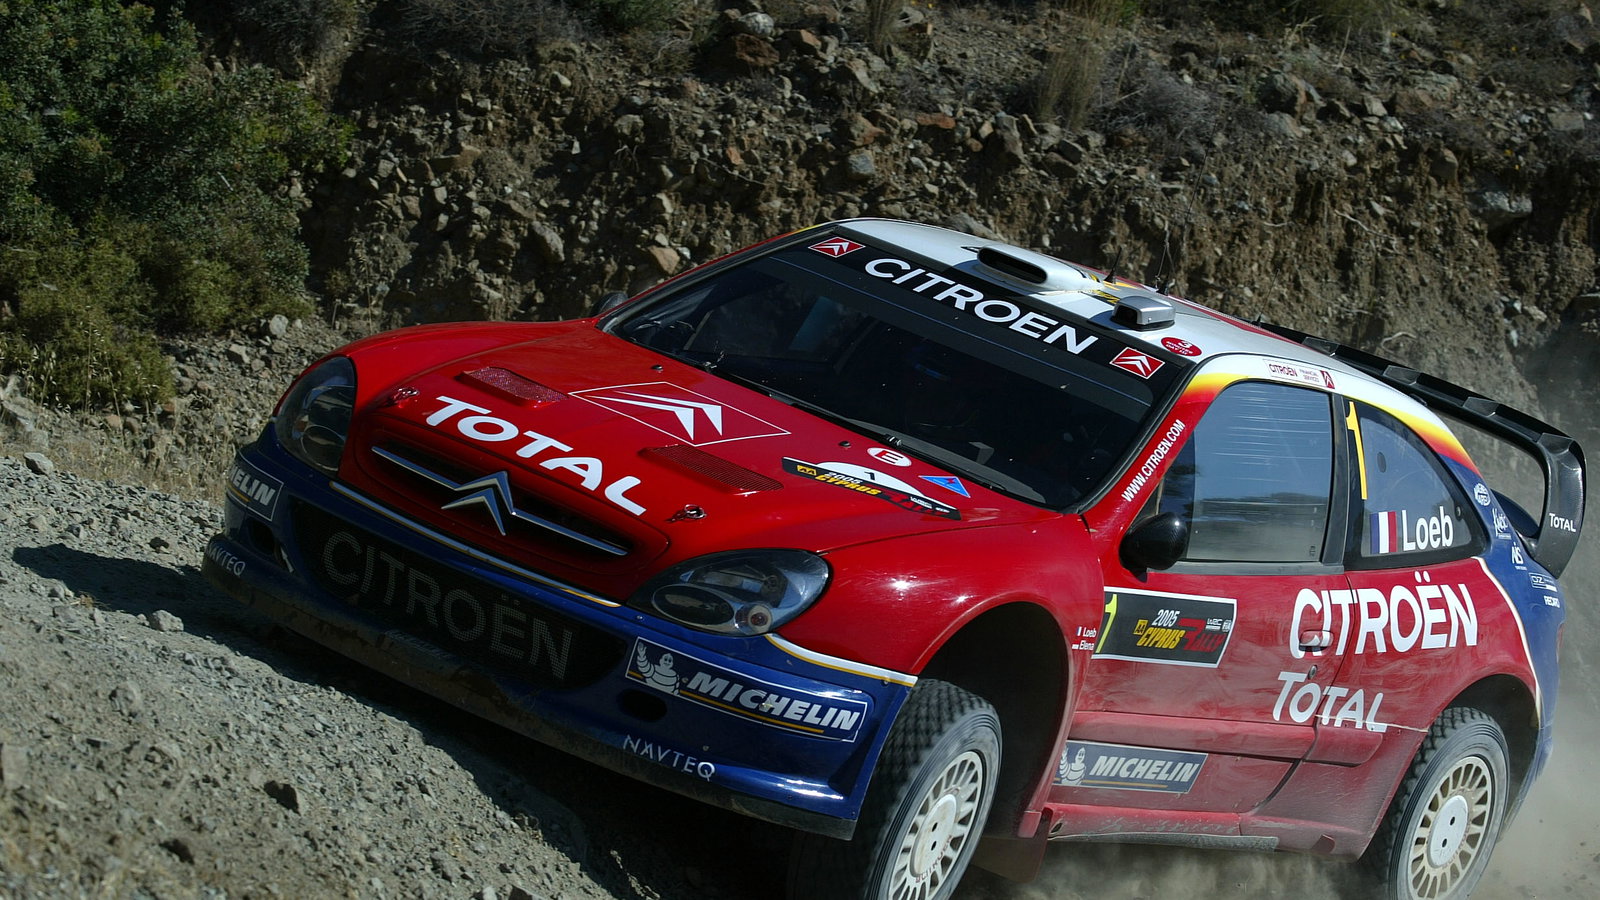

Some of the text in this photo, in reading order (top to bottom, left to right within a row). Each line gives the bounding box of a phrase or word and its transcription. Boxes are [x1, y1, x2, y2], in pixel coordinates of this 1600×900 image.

[865, 258, 1098, 355] CITROEN
[426, 395, 646, 516] TOTAL
[1121, 419, 1185, 502] WWW.CITROEN.COM
[1346, 401, 1367, 499] 1
[815, 475, 881, 495] CYPRUS
[824, 471, 863, 484] 2005
[1402, 506, 1453, 551] Loeb
[1549, 513, 1576, 532] TOTAL
[1083, 627, 1096, 638] Loeb
[1095, 594, 1117, 653] 1
[1136, 626, 1186, 649] CYPRUS
[1151, 609, 1180, 627] 2005
[1290, 571, 1478, 659] CITROËN
[687, 671, 860, 731] MICHELIN
[1273, 671, 1387, 733] TOTAL
[623, 735, 716, 782] NAVTEQ
[1089, 755, 1200, 782] MICHELIN
